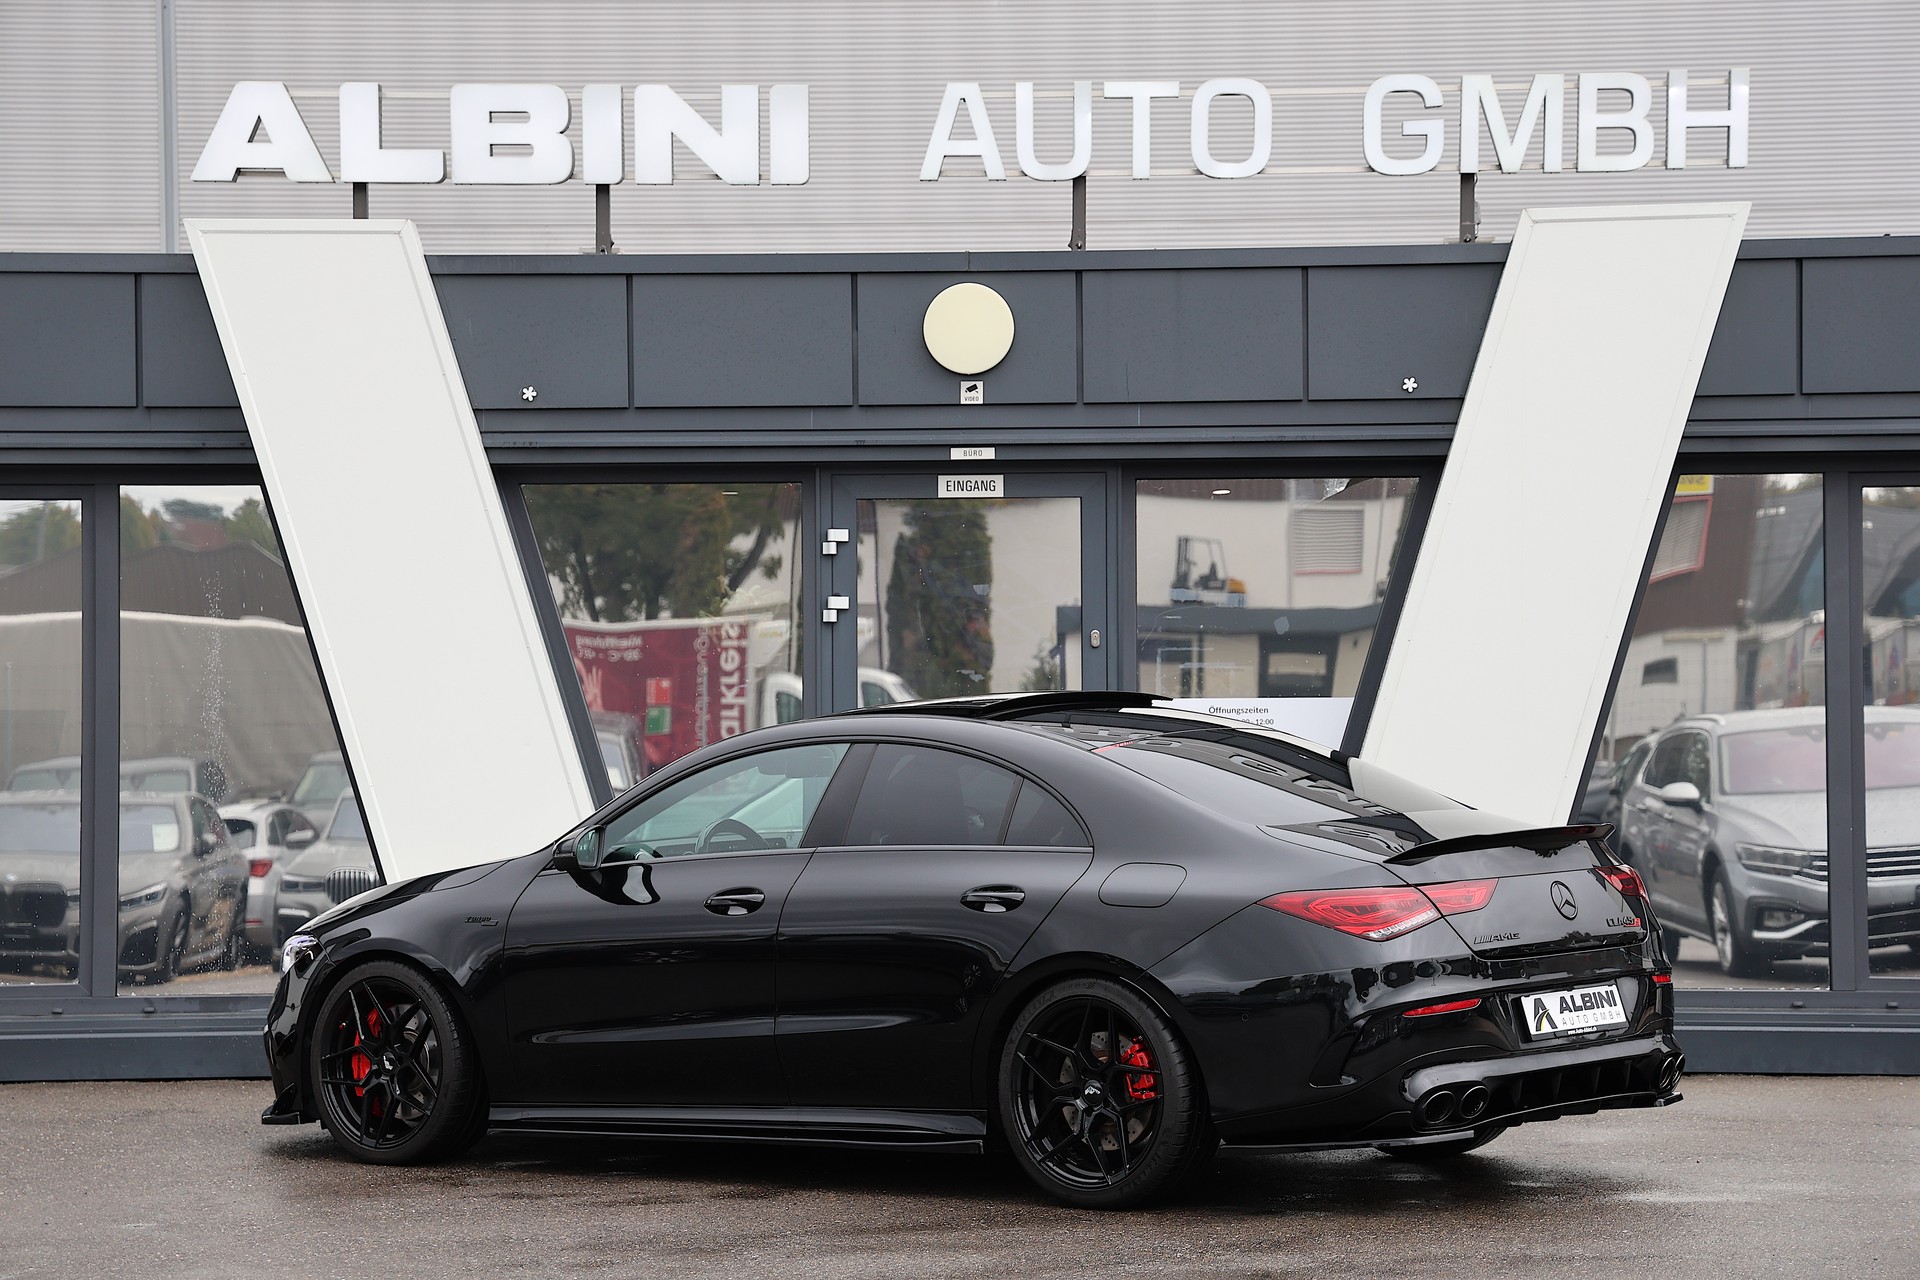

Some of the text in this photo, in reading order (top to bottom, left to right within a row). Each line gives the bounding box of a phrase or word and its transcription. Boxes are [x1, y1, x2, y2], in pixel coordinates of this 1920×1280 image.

[190, 67, 1750, 186] ALBINI AUTO GMBH
[963, 449, 983, 457] BÜRO
[946, 479, 996, 492] EINGANG
[1208, 705, 1269, 715] Öffnungszeiten
[1559, 989, 1618, 1014] ALBINI
[1562, 1010, 1621, 1026] AUTO GMBH
